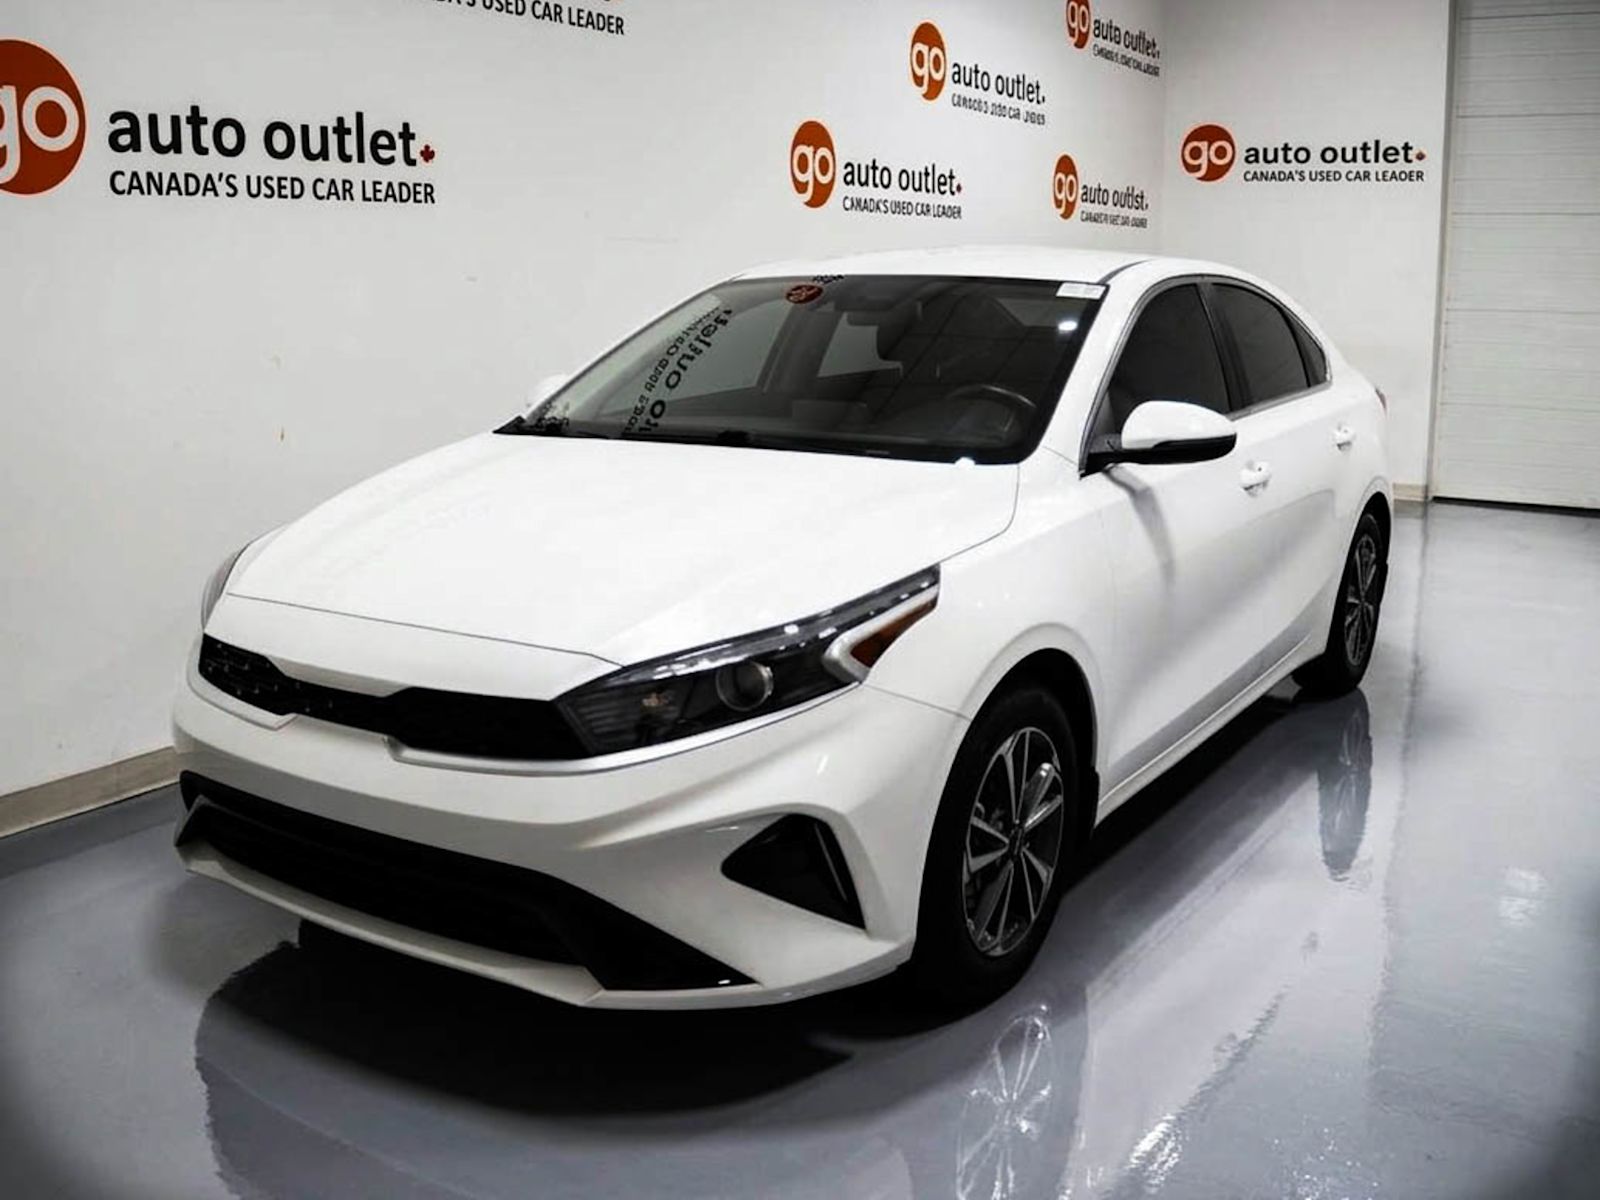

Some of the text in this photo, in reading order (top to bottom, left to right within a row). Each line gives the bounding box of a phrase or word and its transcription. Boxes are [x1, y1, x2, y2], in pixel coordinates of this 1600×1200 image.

[531, 0, 563, 23] CAR
[567, 6, 625, 35] LEADER
[1067, 1, 1090, 49] go
[911, 42, 945, 96] go
[951, 62, 1041, 105] auto outlet
[107, 104, 417, 167] auto outlet
[1244, 139, 1414, 165] auto outlet
[792, 144, 834, 204] go
[843, 158, 956, 197] auto outlet
[1183, 140, 1234, 177] go
[1243, 170, 1425, 183] CANADA'S USED CAR LEADER
[109, 170, 436, 205] CANADA'S USED CAR LEADER
[1055, 172, 1077, 214] go
[1081, 182, 1110, 207] auto
